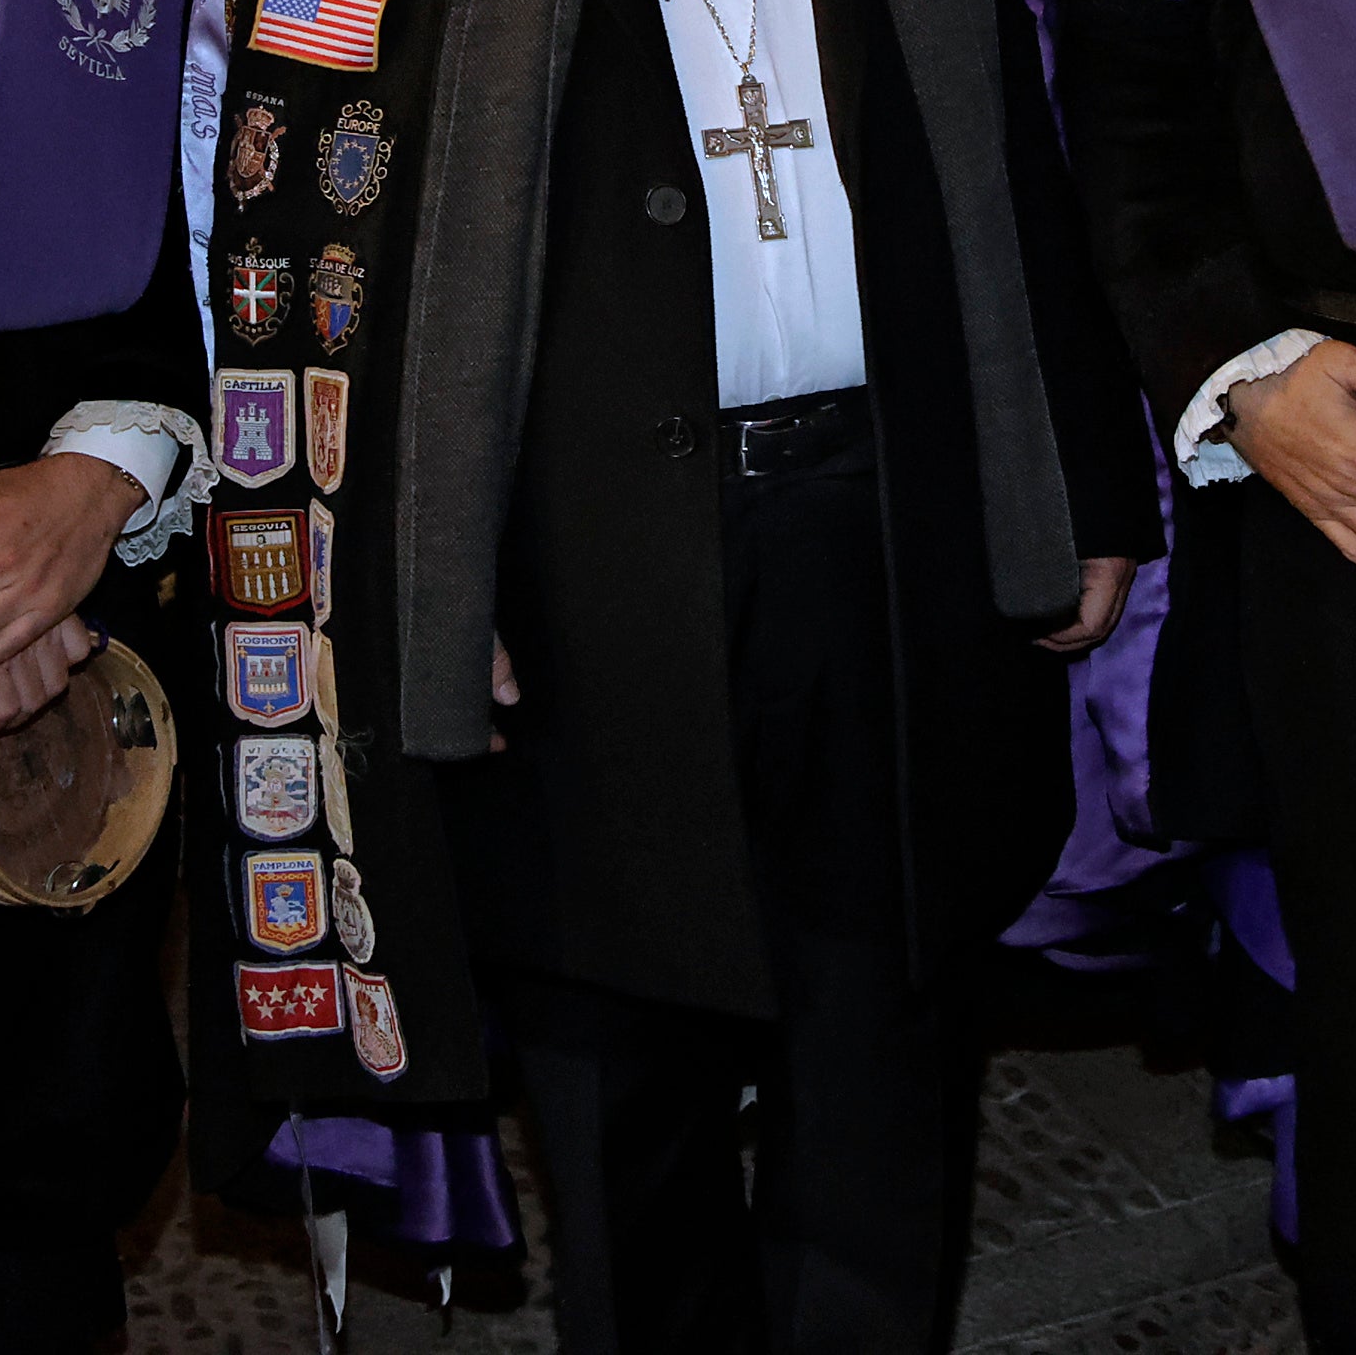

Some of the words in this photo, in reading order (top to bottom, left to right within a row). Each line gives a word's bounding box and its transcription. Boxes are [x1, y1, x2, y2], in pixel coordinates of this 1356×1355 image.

[58, 35, 127, 81] SEVILLA
[337, 117, 381, 135] EUROPE
[244, 256, 292, 269] BASQUE
[334, 263, 347, 275] DE
[347, 267, 366, 278] LUZ
[223, 380, 286, 391] CASTILLA
[232, 521, 289, 533] SEGOVIA
[252, 860, 314, 871] PAMPLONA
